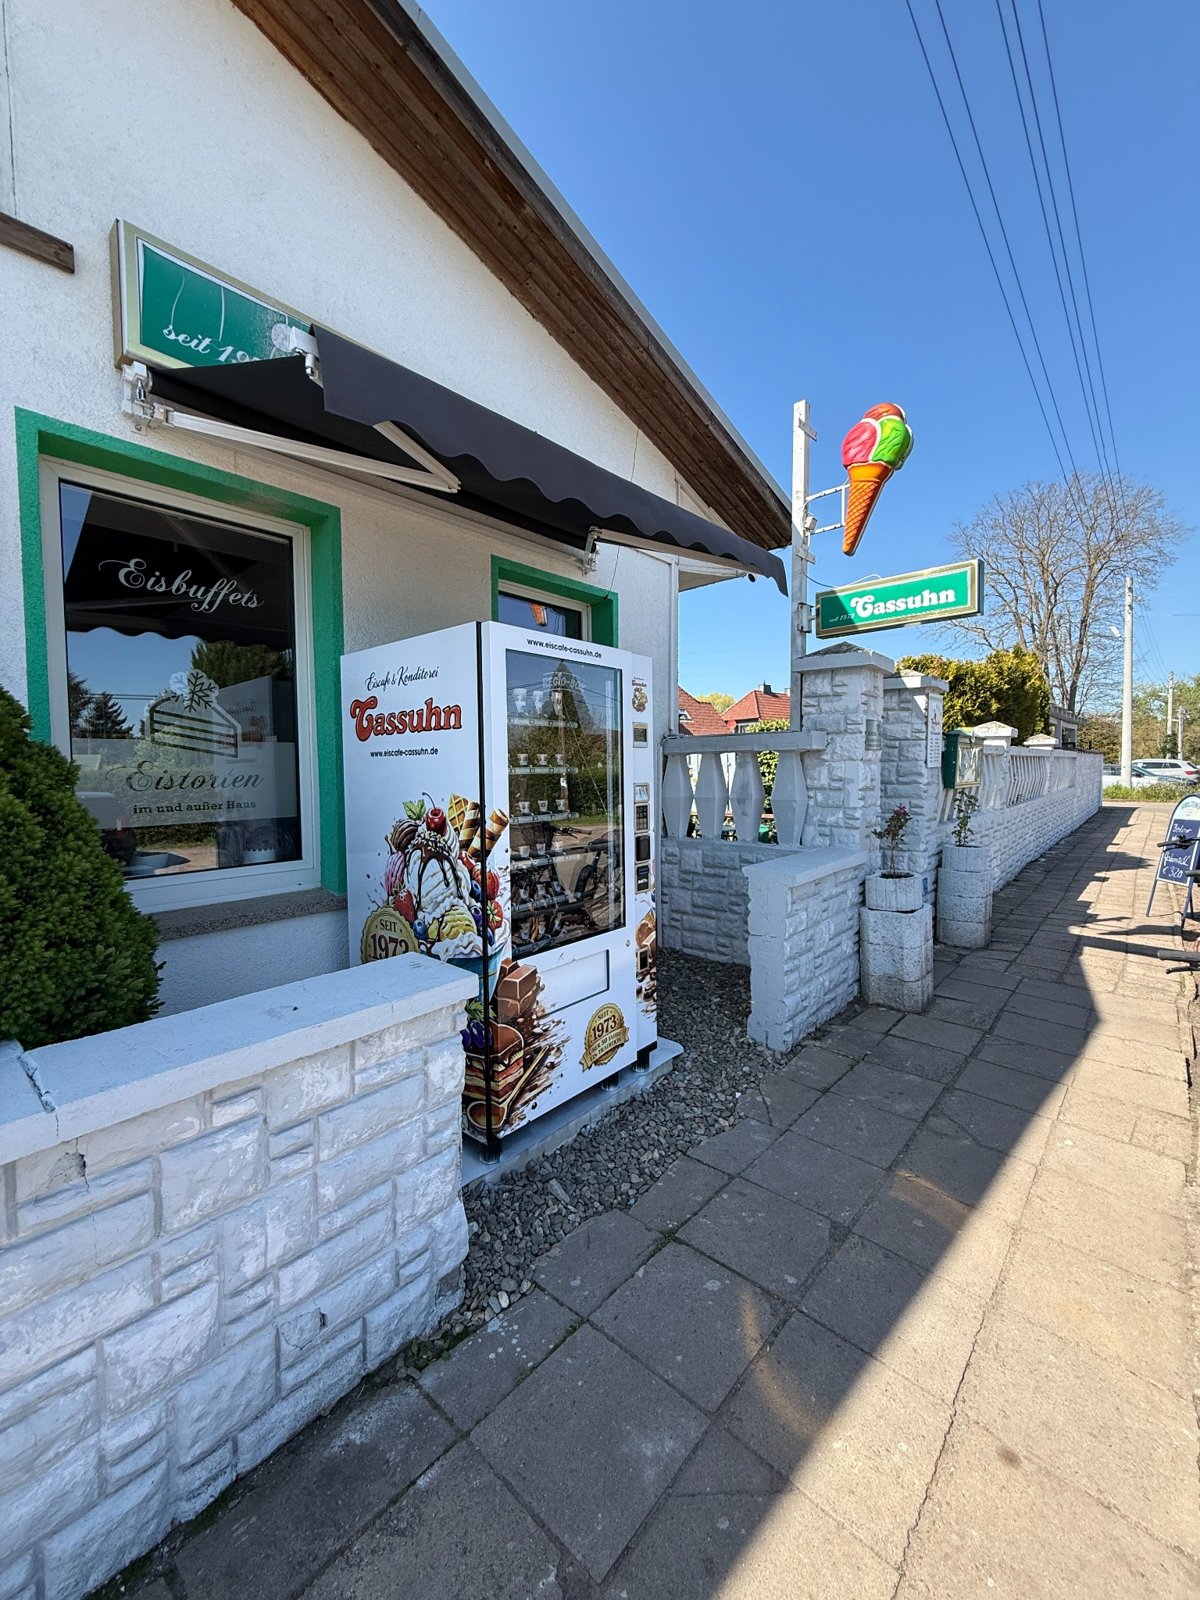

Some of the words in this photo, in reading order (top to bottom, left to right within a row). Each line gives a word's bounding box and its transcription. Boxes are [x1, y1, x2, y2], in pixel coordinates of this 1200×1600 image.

[162, 325, 211, 354] seit
[98, 558, 264, 614] Eisbuffets
[850, 588, 956, 618] Cassuhn
[526, 638, 602, 659] www.eiscafe-cassuhn.de
[397, 666, 440, 687] Konditorei
[350, 695, 462, 742] Cassuhn
[370, 746, 438, 757] www.eiscafe-cassuhn.de
[133, 804, 151, 814] im
[156, 803, 182, 813] und
[186, 801, 223, 812] außer
[226, 800, 257, 810] Haus
[380, 919, 397, 933] SEIT
[598, 1010, 609, 1020] SEIT
[592, 1014, 617, 1040] 1973
